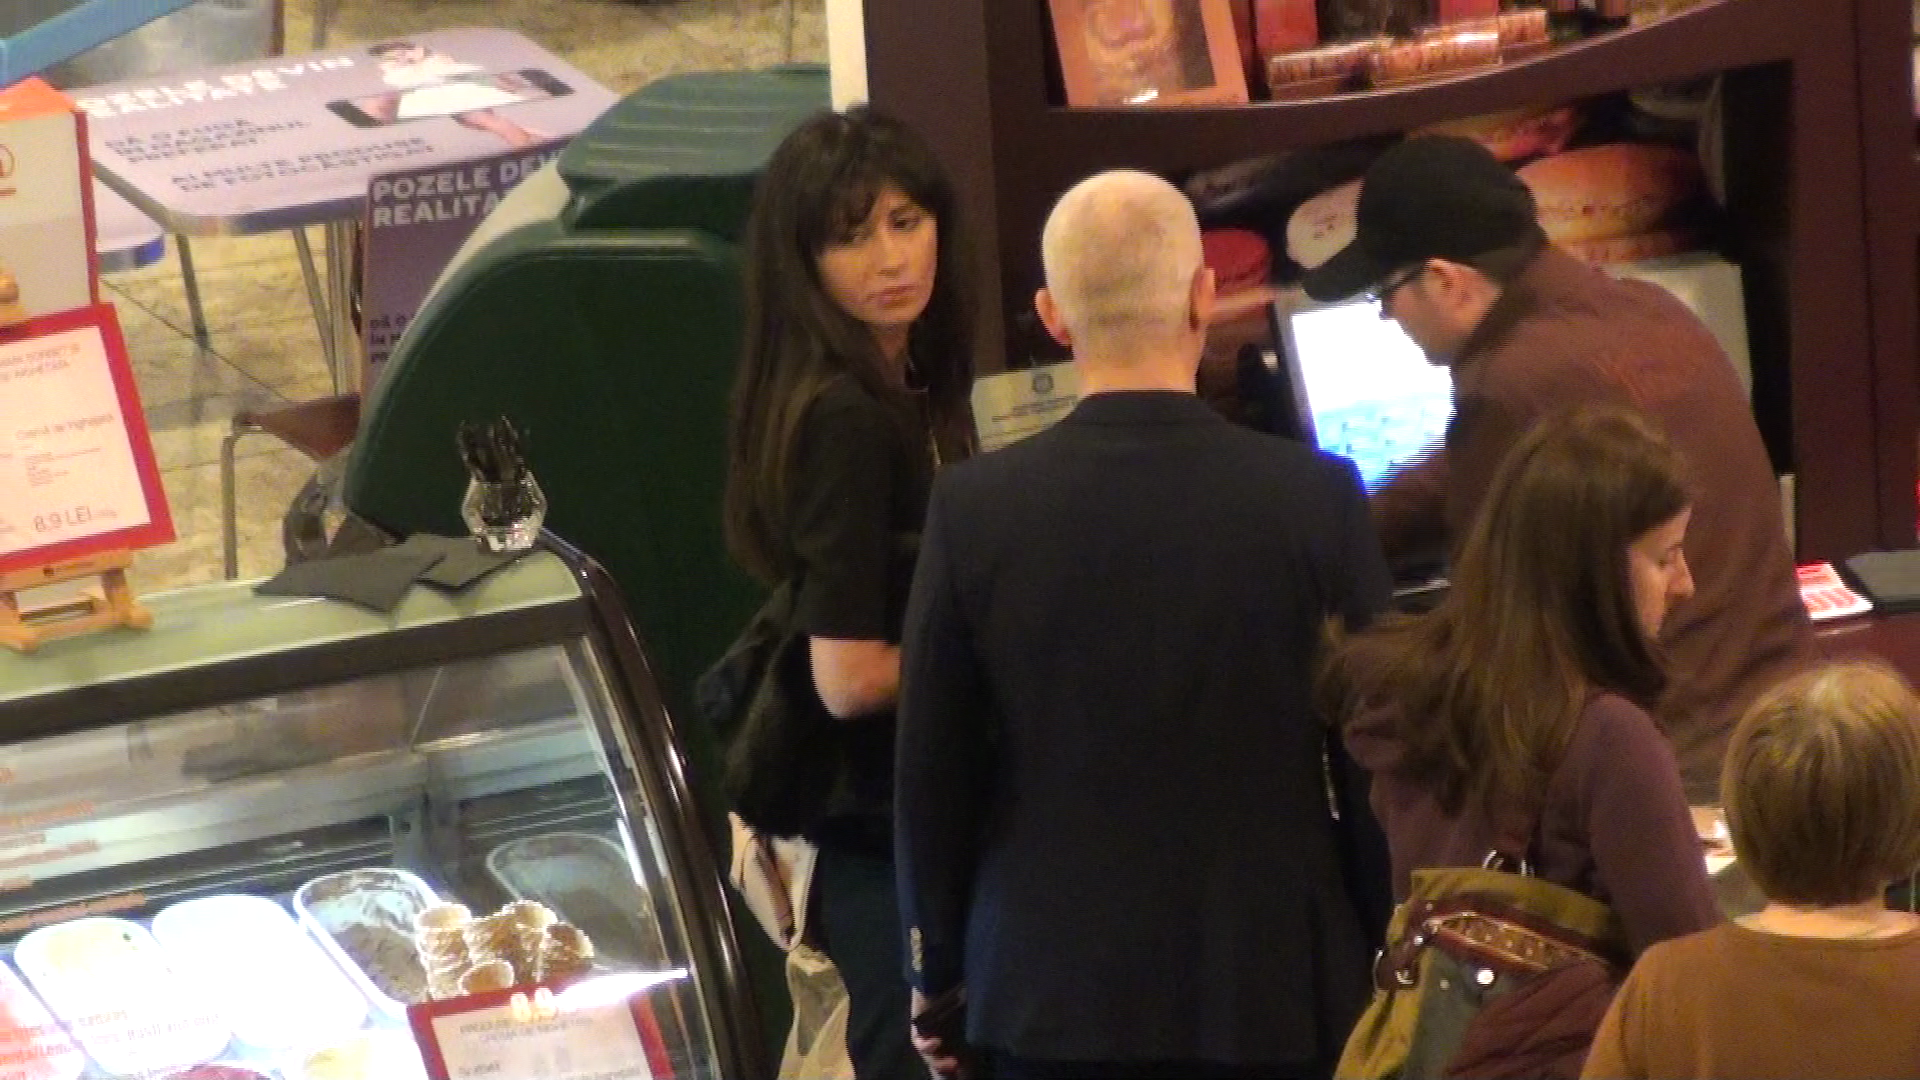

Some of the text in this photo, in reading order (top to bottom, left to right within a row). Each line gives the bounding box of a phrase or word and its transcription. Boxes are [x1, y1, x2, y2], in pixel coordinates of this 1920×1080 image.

[373, 166, 492, 203] POZELE
[373, 191, 501, 229] REALITA
[65, 505, 93, 527] LEI
